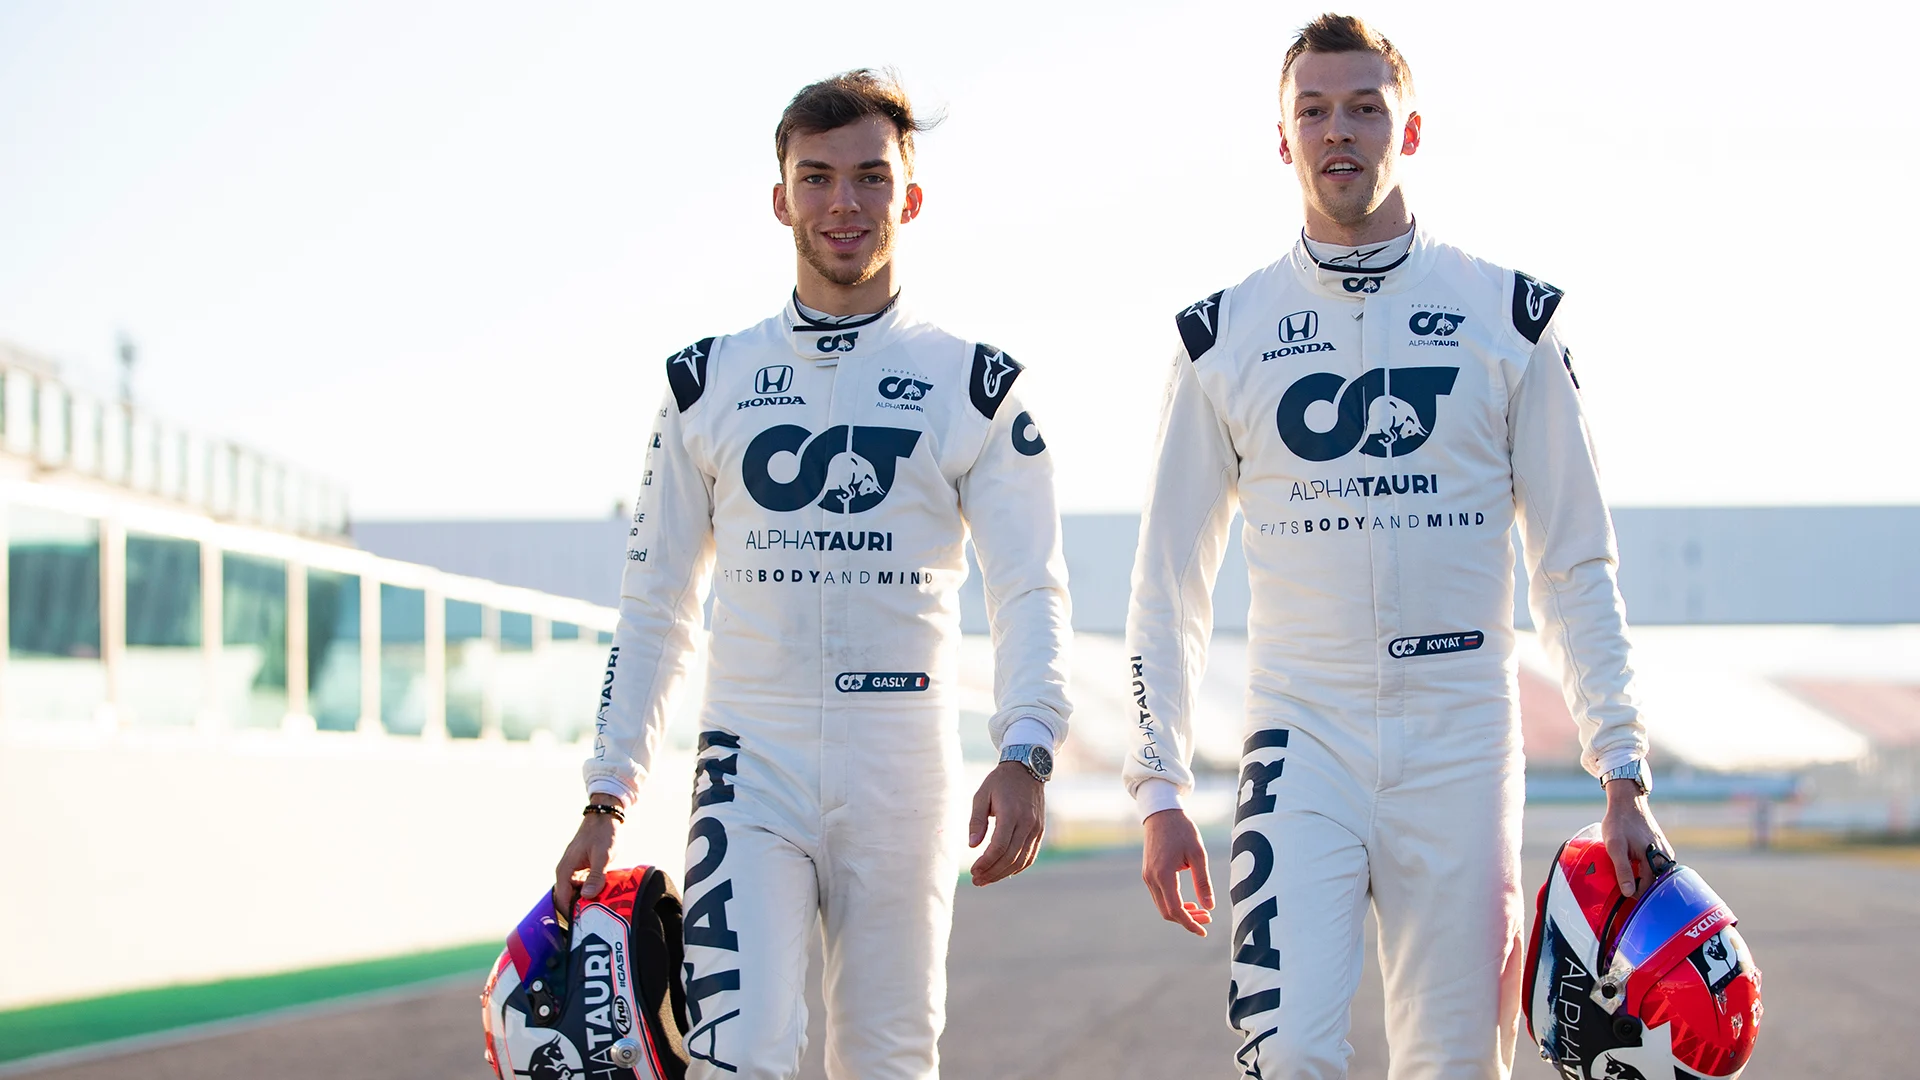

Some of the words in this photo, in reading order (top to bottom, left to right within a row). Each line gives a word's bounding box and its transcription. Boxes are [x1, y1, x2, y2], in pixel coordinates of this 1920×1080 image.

[1408, 339, 1460, 347] ALPHATAURI
[1261, 341, 1337, 362] HONDA
[736, 395, 806, 411] HONDA
[875, 401, 924, 413] ALPHATAURI
[1289, 473, 1438, 502] ALPHATAURI
[745, 530, 893, 552] ALPHATAURI
[1426, 637, 1461, 651] KVYAT
[872, 676, 908, 688] GASLY
[614, 999, 631, 1034] Arai
